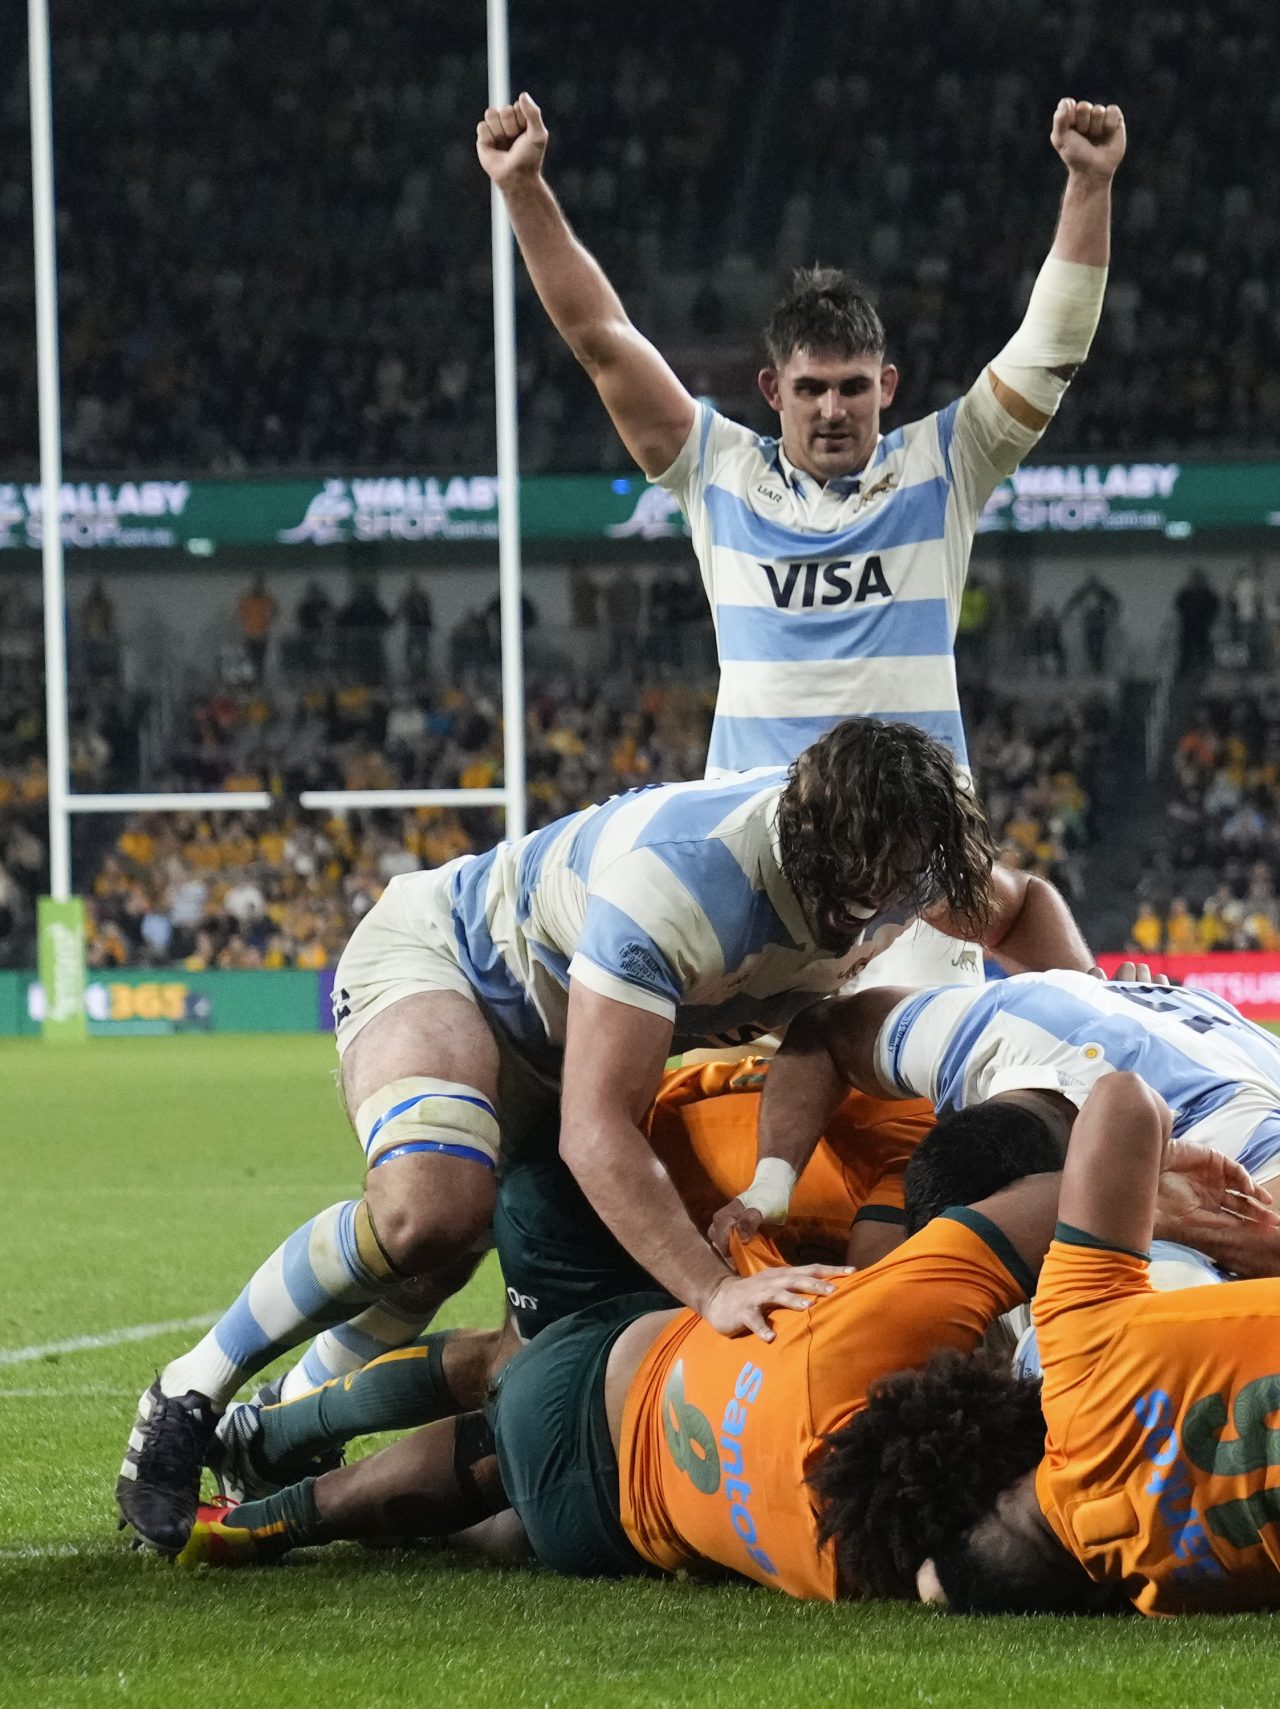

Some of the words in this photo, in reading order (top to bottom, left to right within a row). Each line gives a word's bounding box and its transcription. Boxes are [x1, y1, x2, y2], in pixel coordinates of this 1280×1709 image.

[352, 476, 498, 512] WALLAB
[757, 483, 783, 503] UAR
[758, 556, 893, 608] VISA
